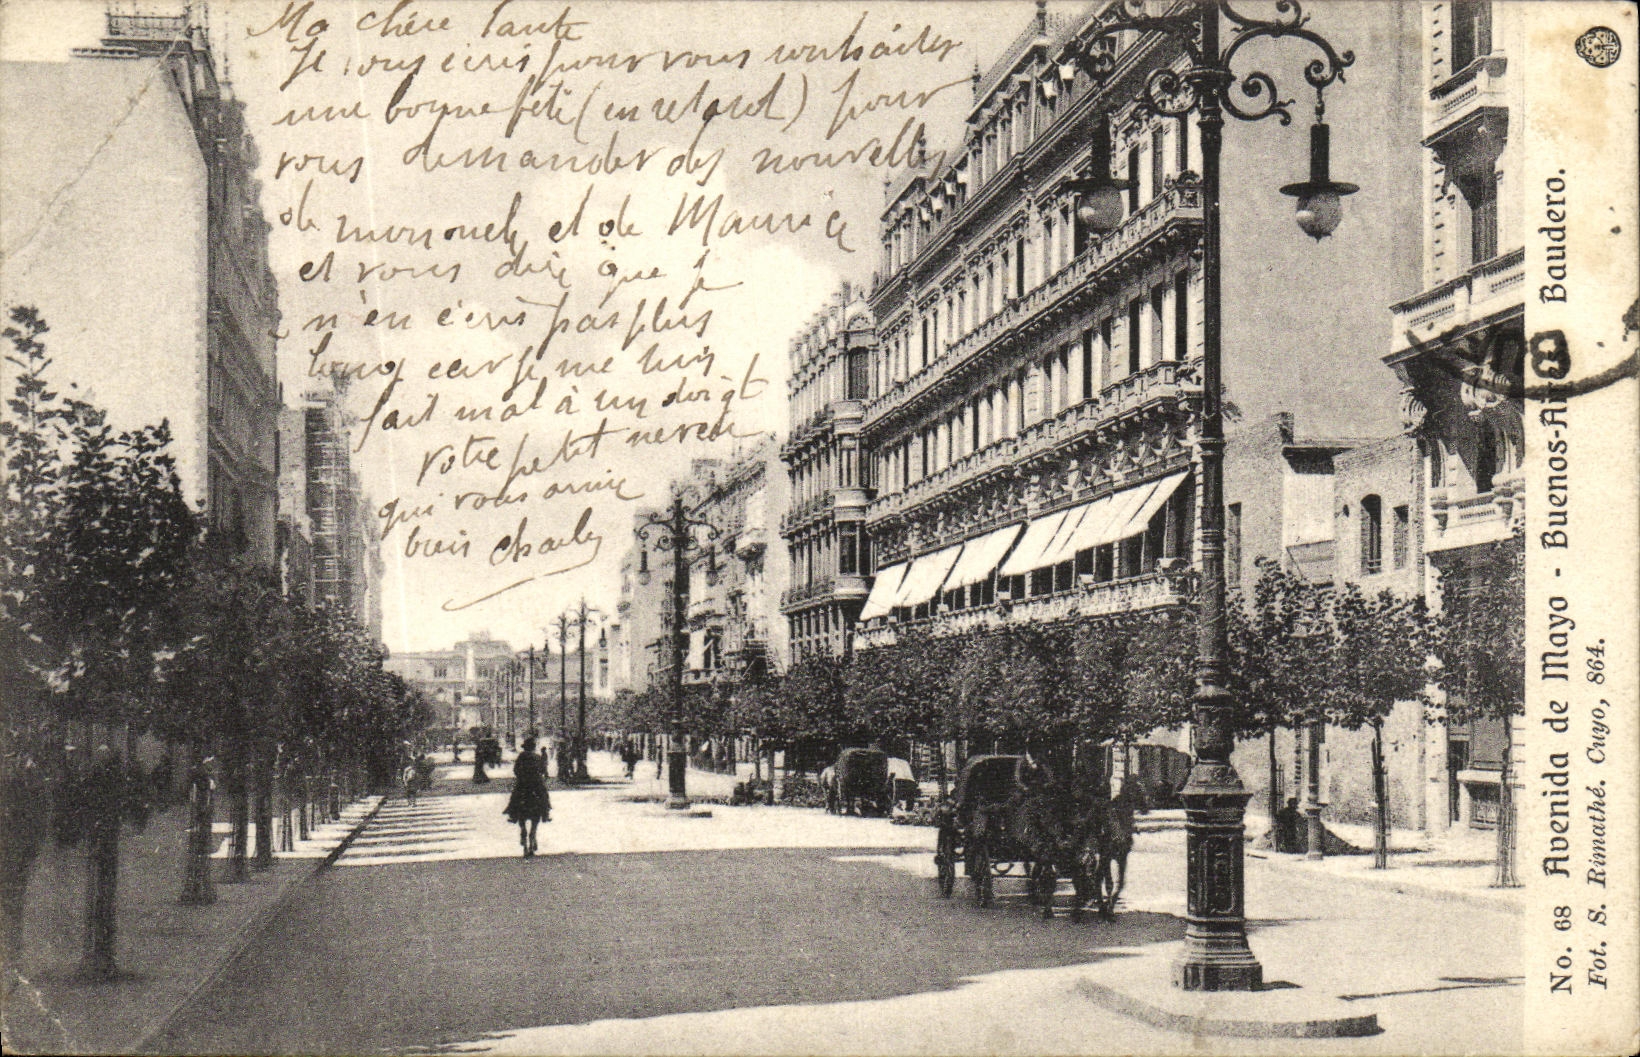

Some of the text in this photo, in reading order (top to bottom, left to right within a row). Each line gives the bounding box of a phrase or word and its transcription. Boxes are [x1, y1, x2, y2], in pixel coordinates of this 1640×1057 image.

[280, 37, 327, 92] Je
[648, 49, 752, 72] vous
[272, 100, 371, 126] une
[825, 68, 975, 140] pour
[275, 151, 364, 183] vous
[279, 179, 320, 231] de
[548, 183, 595, 243] et
[599, 194, 642, 238] de
[299, 251, 334, 282] et
[358, 262, 461, 284] vous
